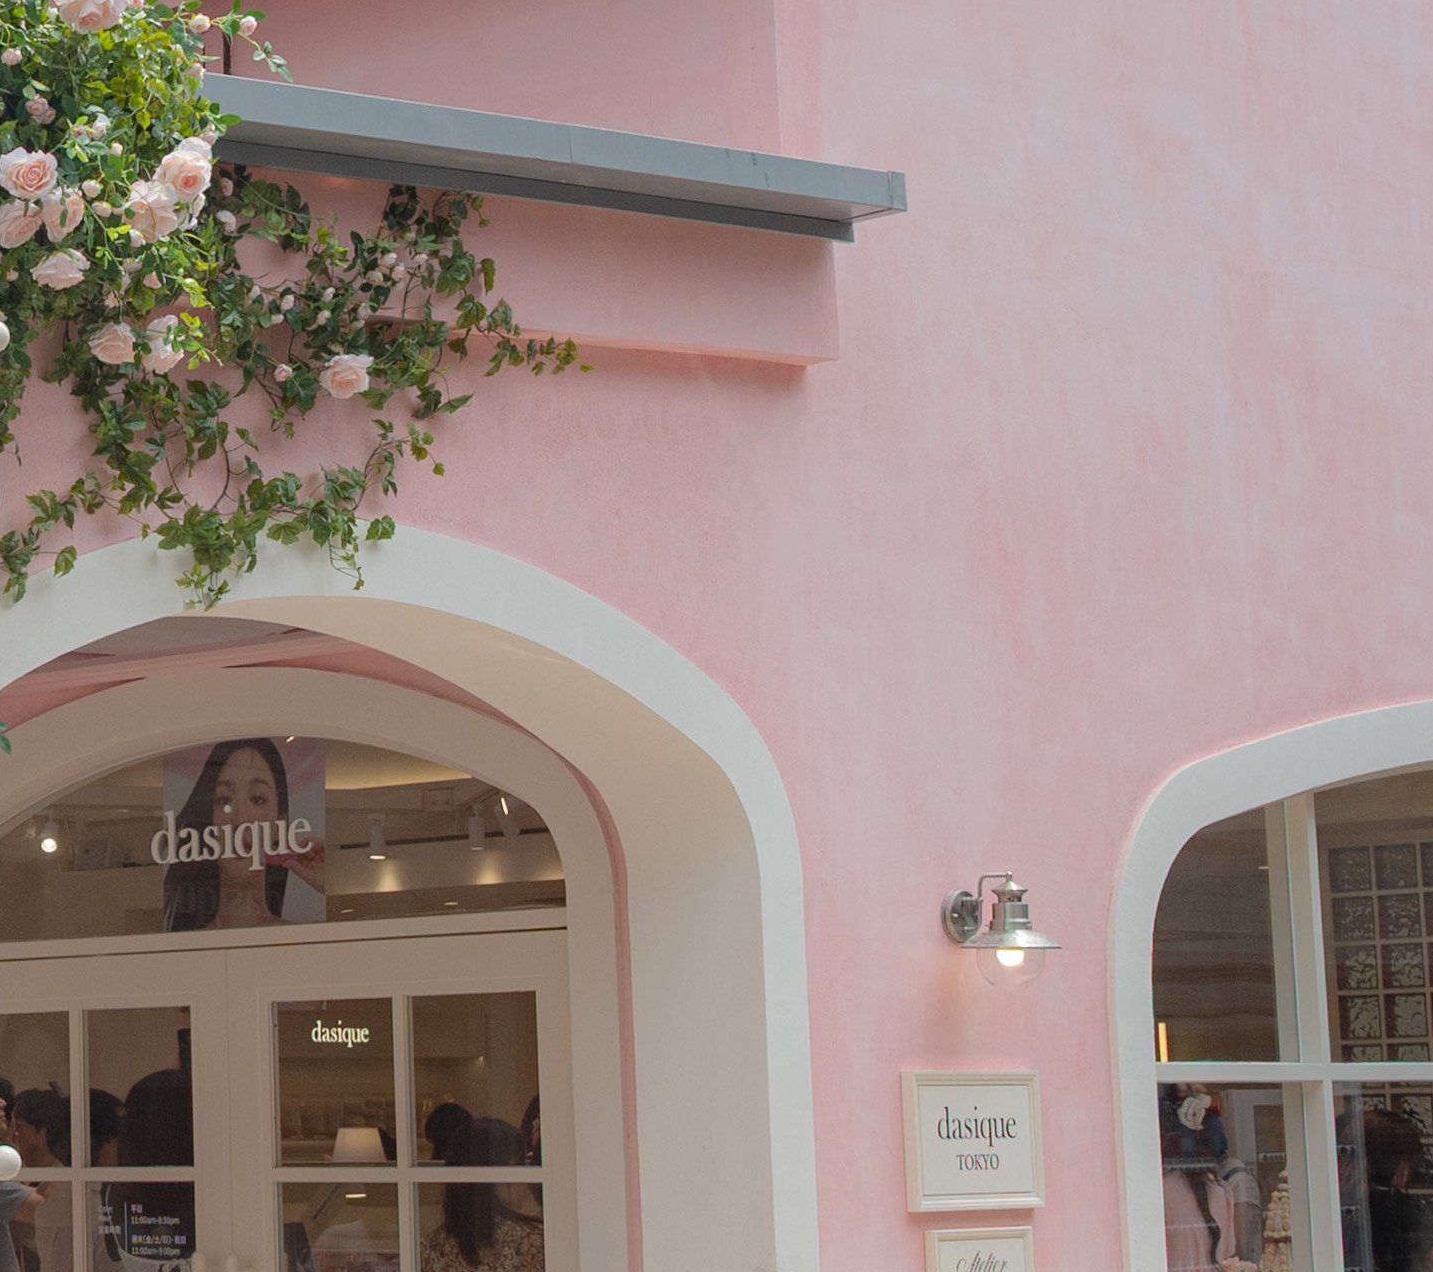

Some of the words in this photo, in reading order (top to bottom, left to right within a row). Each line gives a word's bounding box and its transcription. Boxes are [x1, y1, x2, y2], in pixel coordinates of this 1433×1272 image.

[150, 804, 314, 871] dasique
[311, 1020, 370, 1048] dasique
[937, 1106, 1017, 1147] dasique
[956, 1153, 1000, 1171] TOKYO
